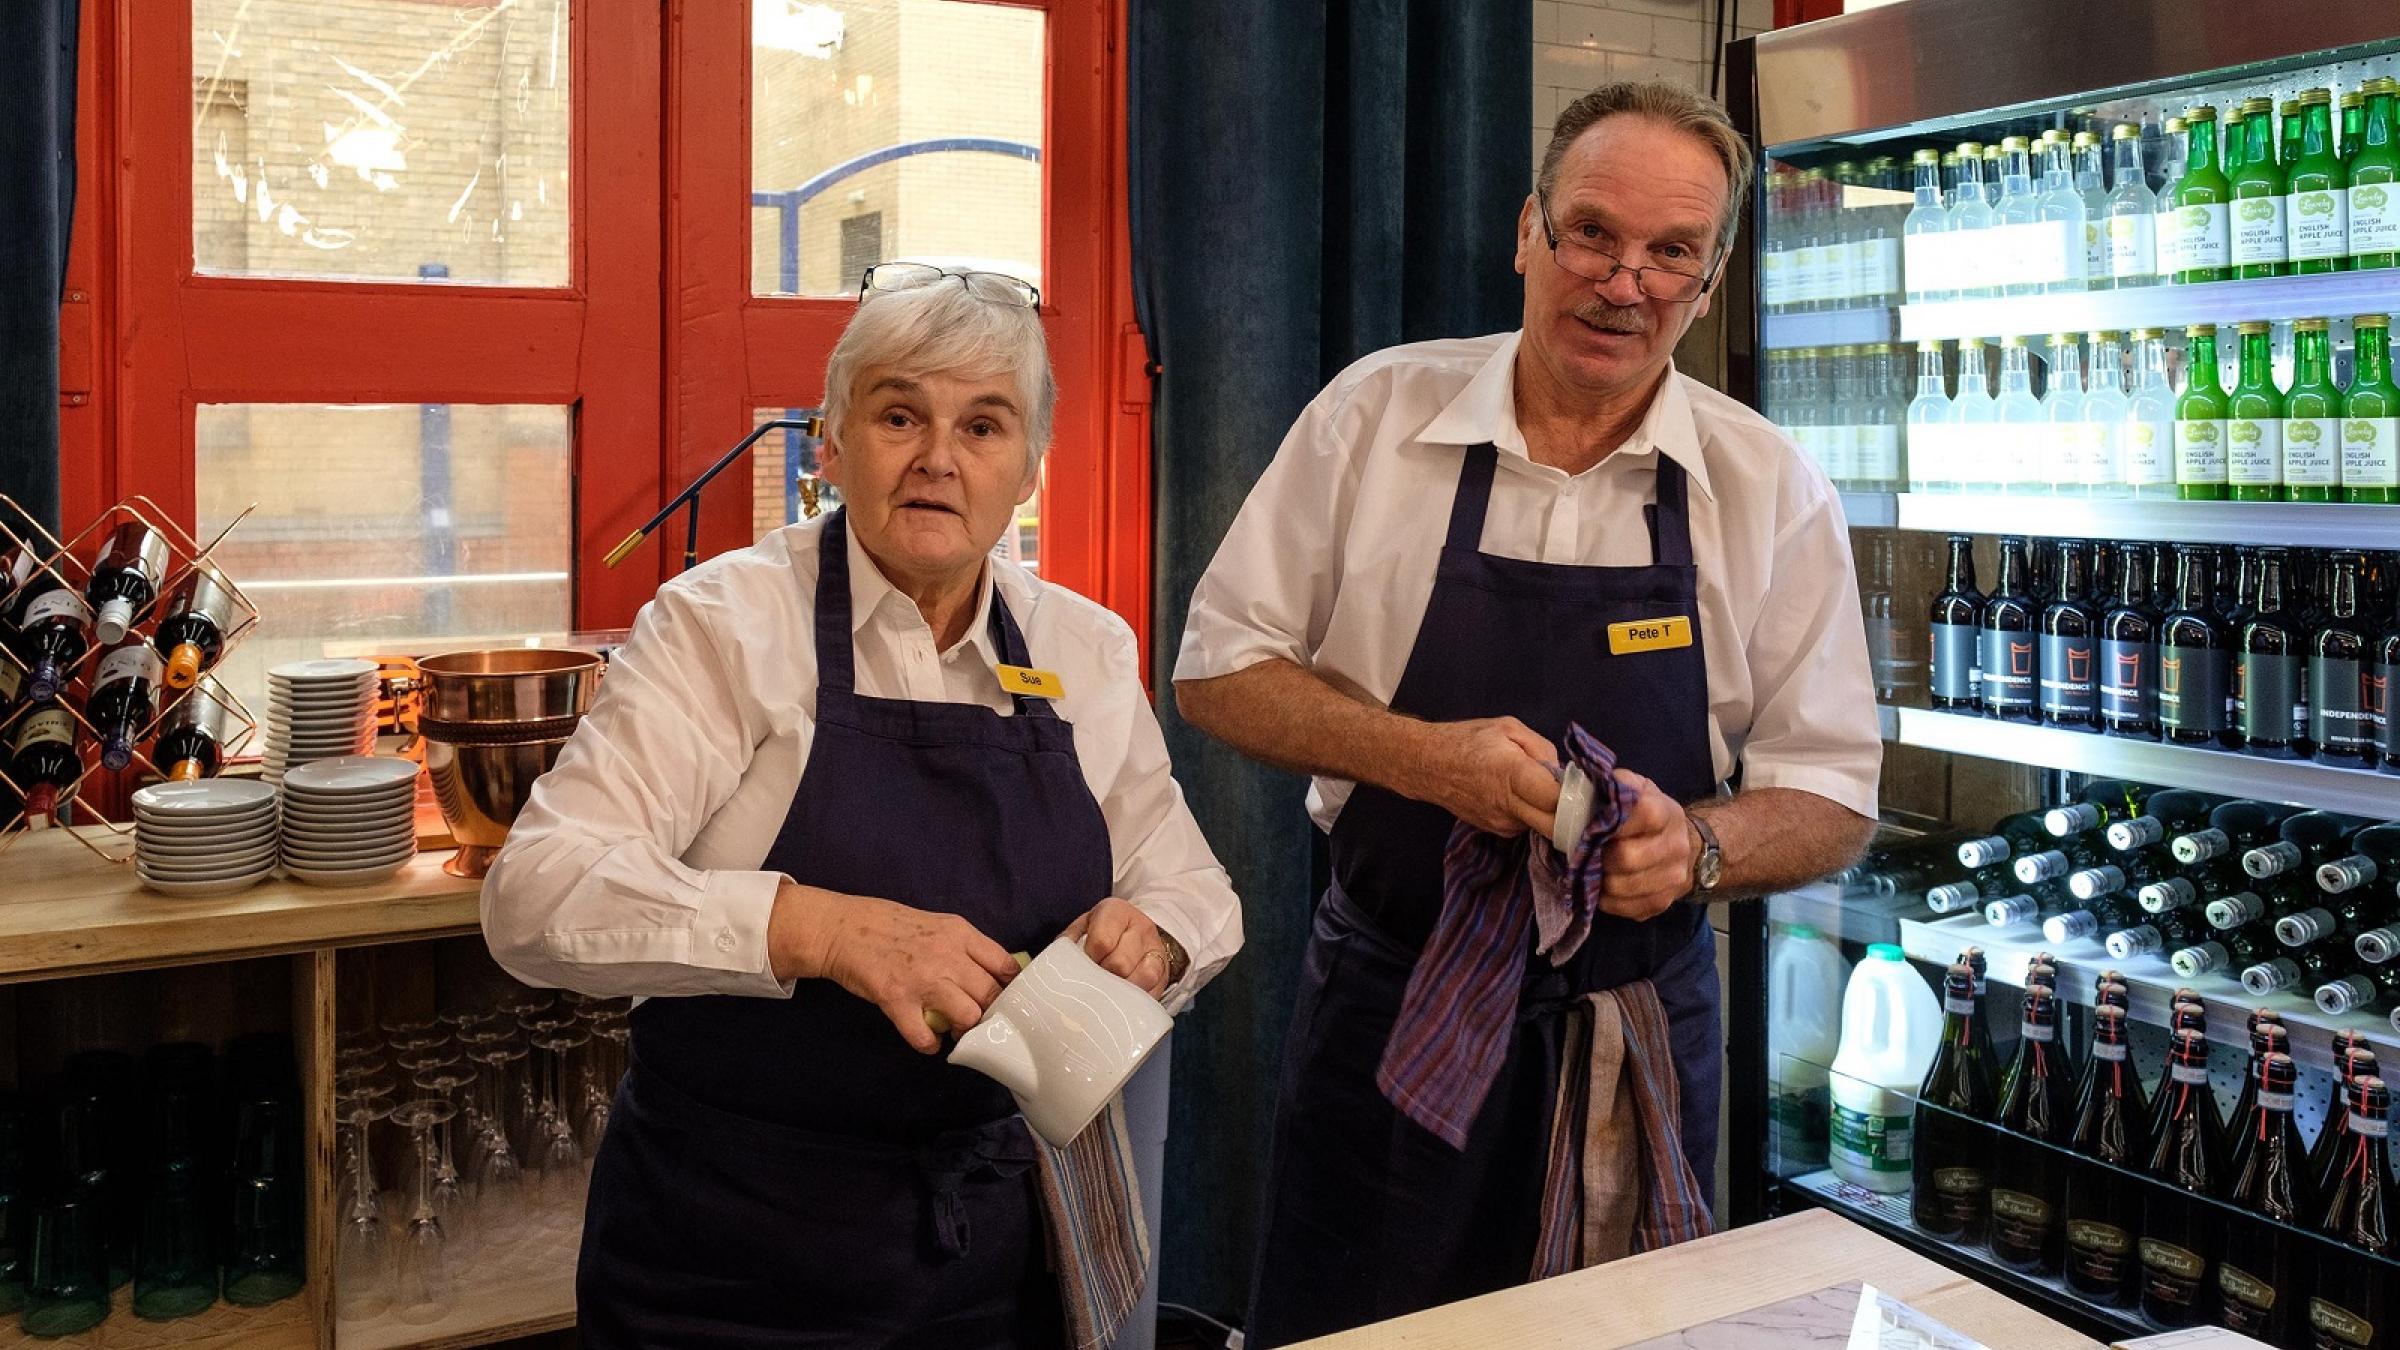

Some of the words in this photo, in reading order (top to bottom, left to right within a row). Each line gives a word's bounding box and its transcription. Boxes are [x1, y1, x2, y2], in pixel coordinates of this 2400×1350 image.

[2299, 224, 2329, 232] ENGLISH
[2375, 224, 2397, 232] JUICE
[2240, 229, 2270, 237] ENGLISH
[2299, 232, 2322, 240] APPLE
[2324, 230, 2343, 238] JUICE
[2240, 237, 2262, 245] APPLE
[1629, 628, 1660, 641] Pete
[1662, 624, 1671, 637] T
[1020, 672, 1042, 685] Sue
